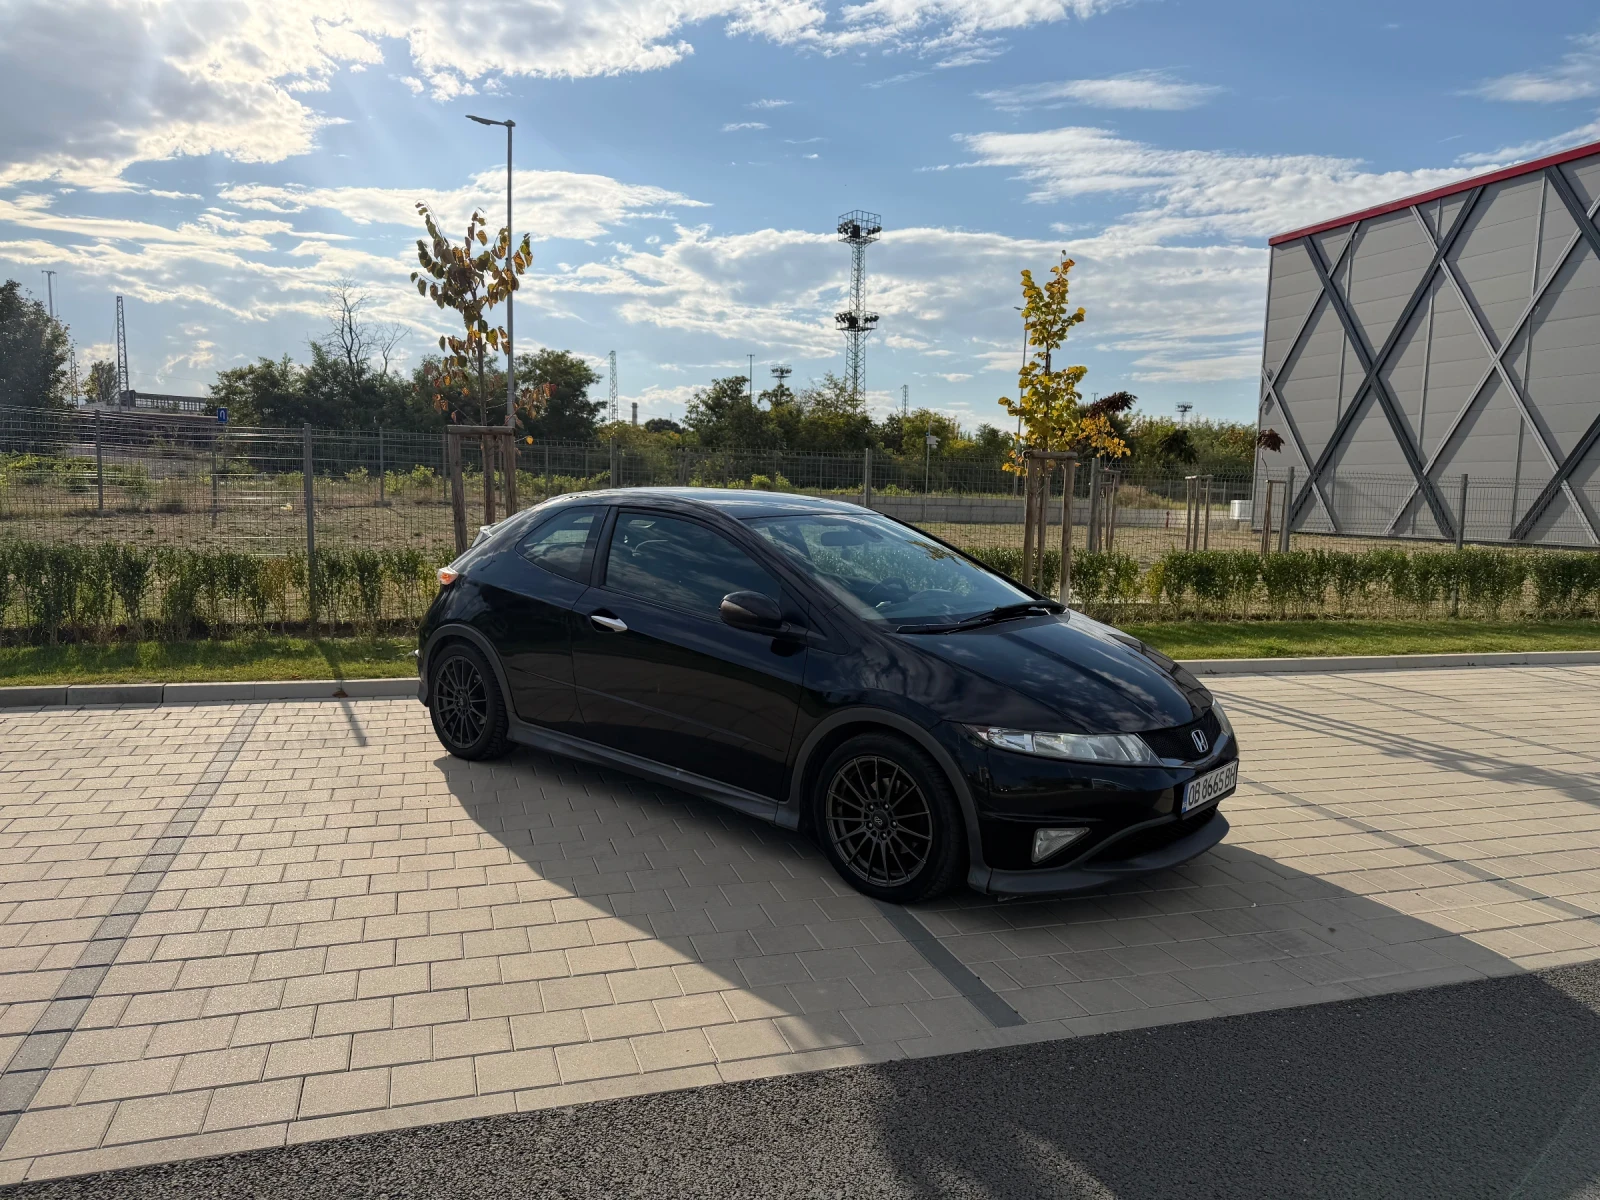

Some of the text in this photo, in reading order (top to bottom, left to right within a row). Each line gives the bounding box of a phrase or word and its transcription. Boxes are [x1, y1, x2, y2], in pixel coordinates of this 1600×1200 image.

[1188, 764, 1237, 806] OB 8665 BH
